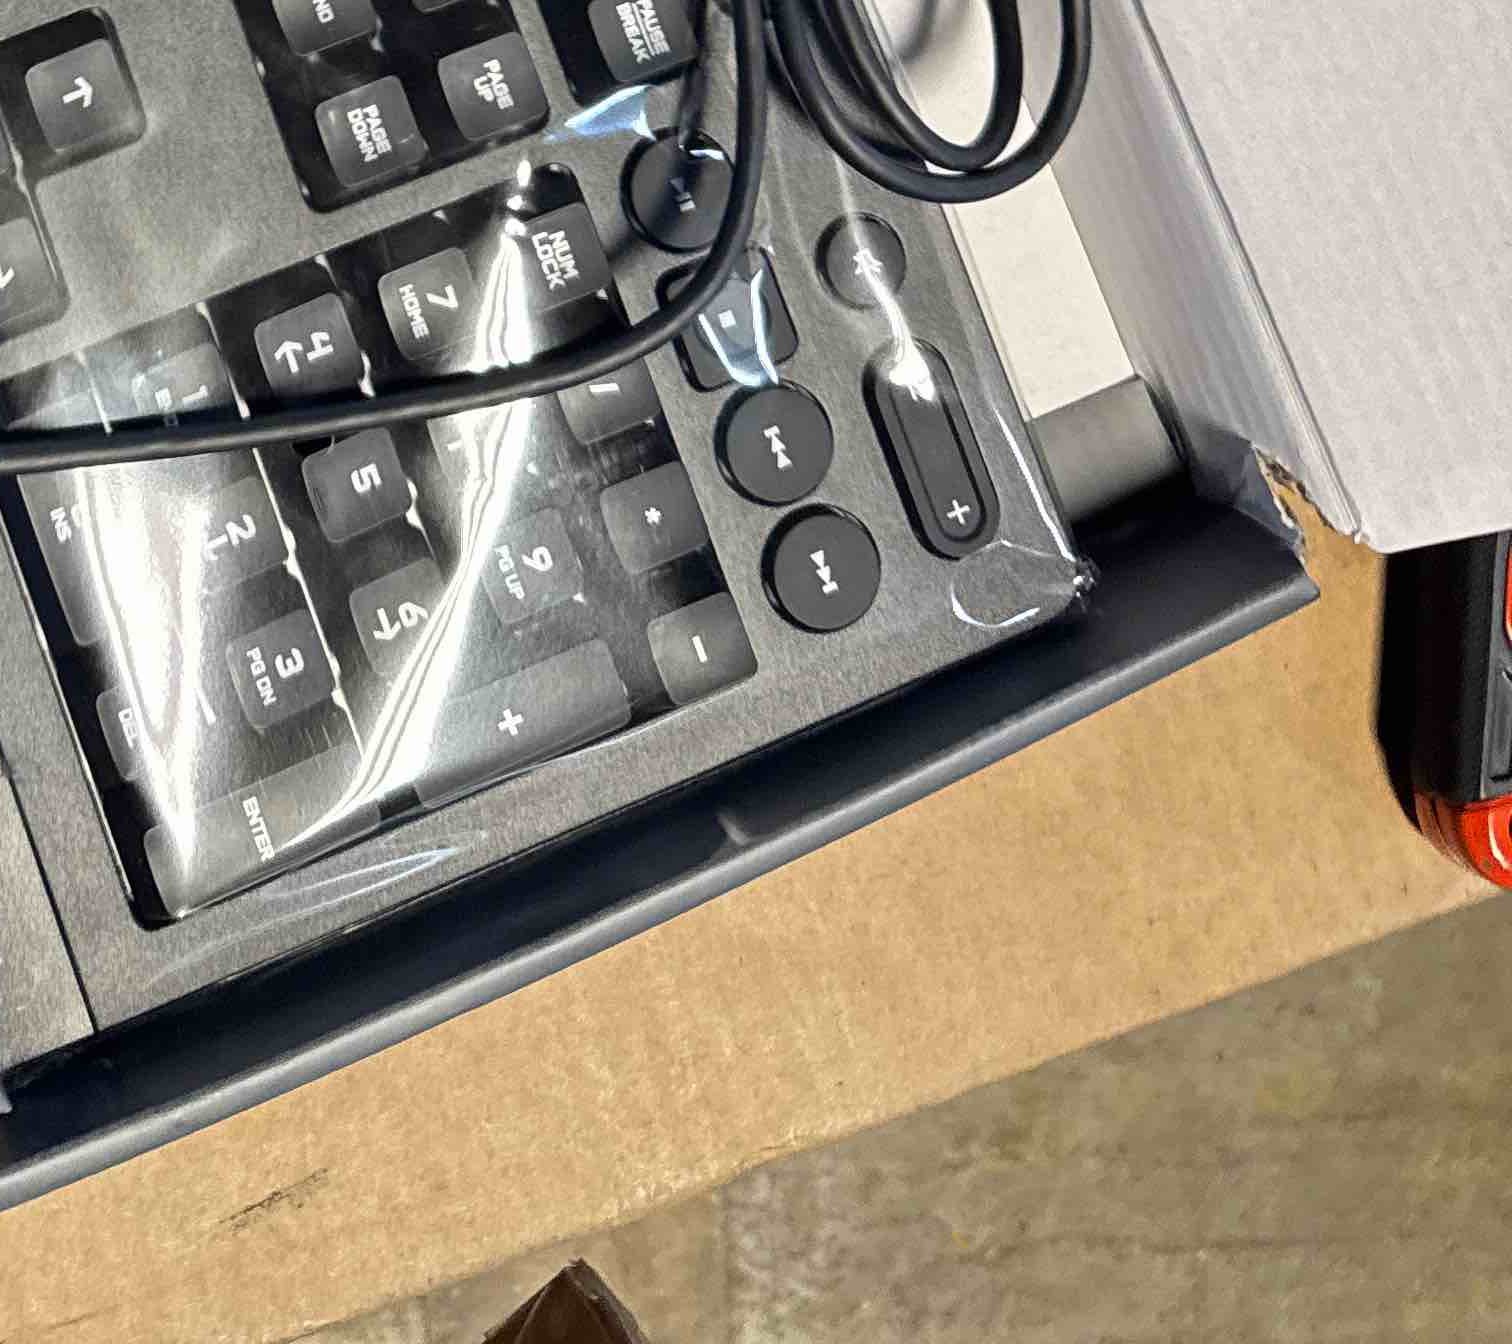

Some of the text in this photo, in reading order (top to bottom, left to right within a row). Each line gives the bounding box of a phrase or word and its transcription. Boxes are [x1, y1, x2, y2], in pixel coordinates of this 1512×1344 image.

[615, 1, 650, 63] BREAK
[473, 76, 495, 102] UP
[483, 59, 514, 109] PAGE
[347, 108, 378, 162] DOWN
[362, 104, 392, 154] PAGE
[532, 232, 566, 290] LOCK
[548, 230, 579, 279] NUM
[398, 283, 429, 339] HOME
[425, 284, 459, 309] 7
[298, 331, 334, 362] 4
[350, 463, 382, 494] 5
[50, 507, 72, 542] INS
[224, 514, 257, 547] 2
[493, 545, 525, 599] PG UP
[522, 546, 552, 571] 9
[397, 601, 433, 629] 6
[246, 646, 277, 706] PG DN
[274, 647, 305, 679] 3
[243, 796, 275, 861] ENTER
